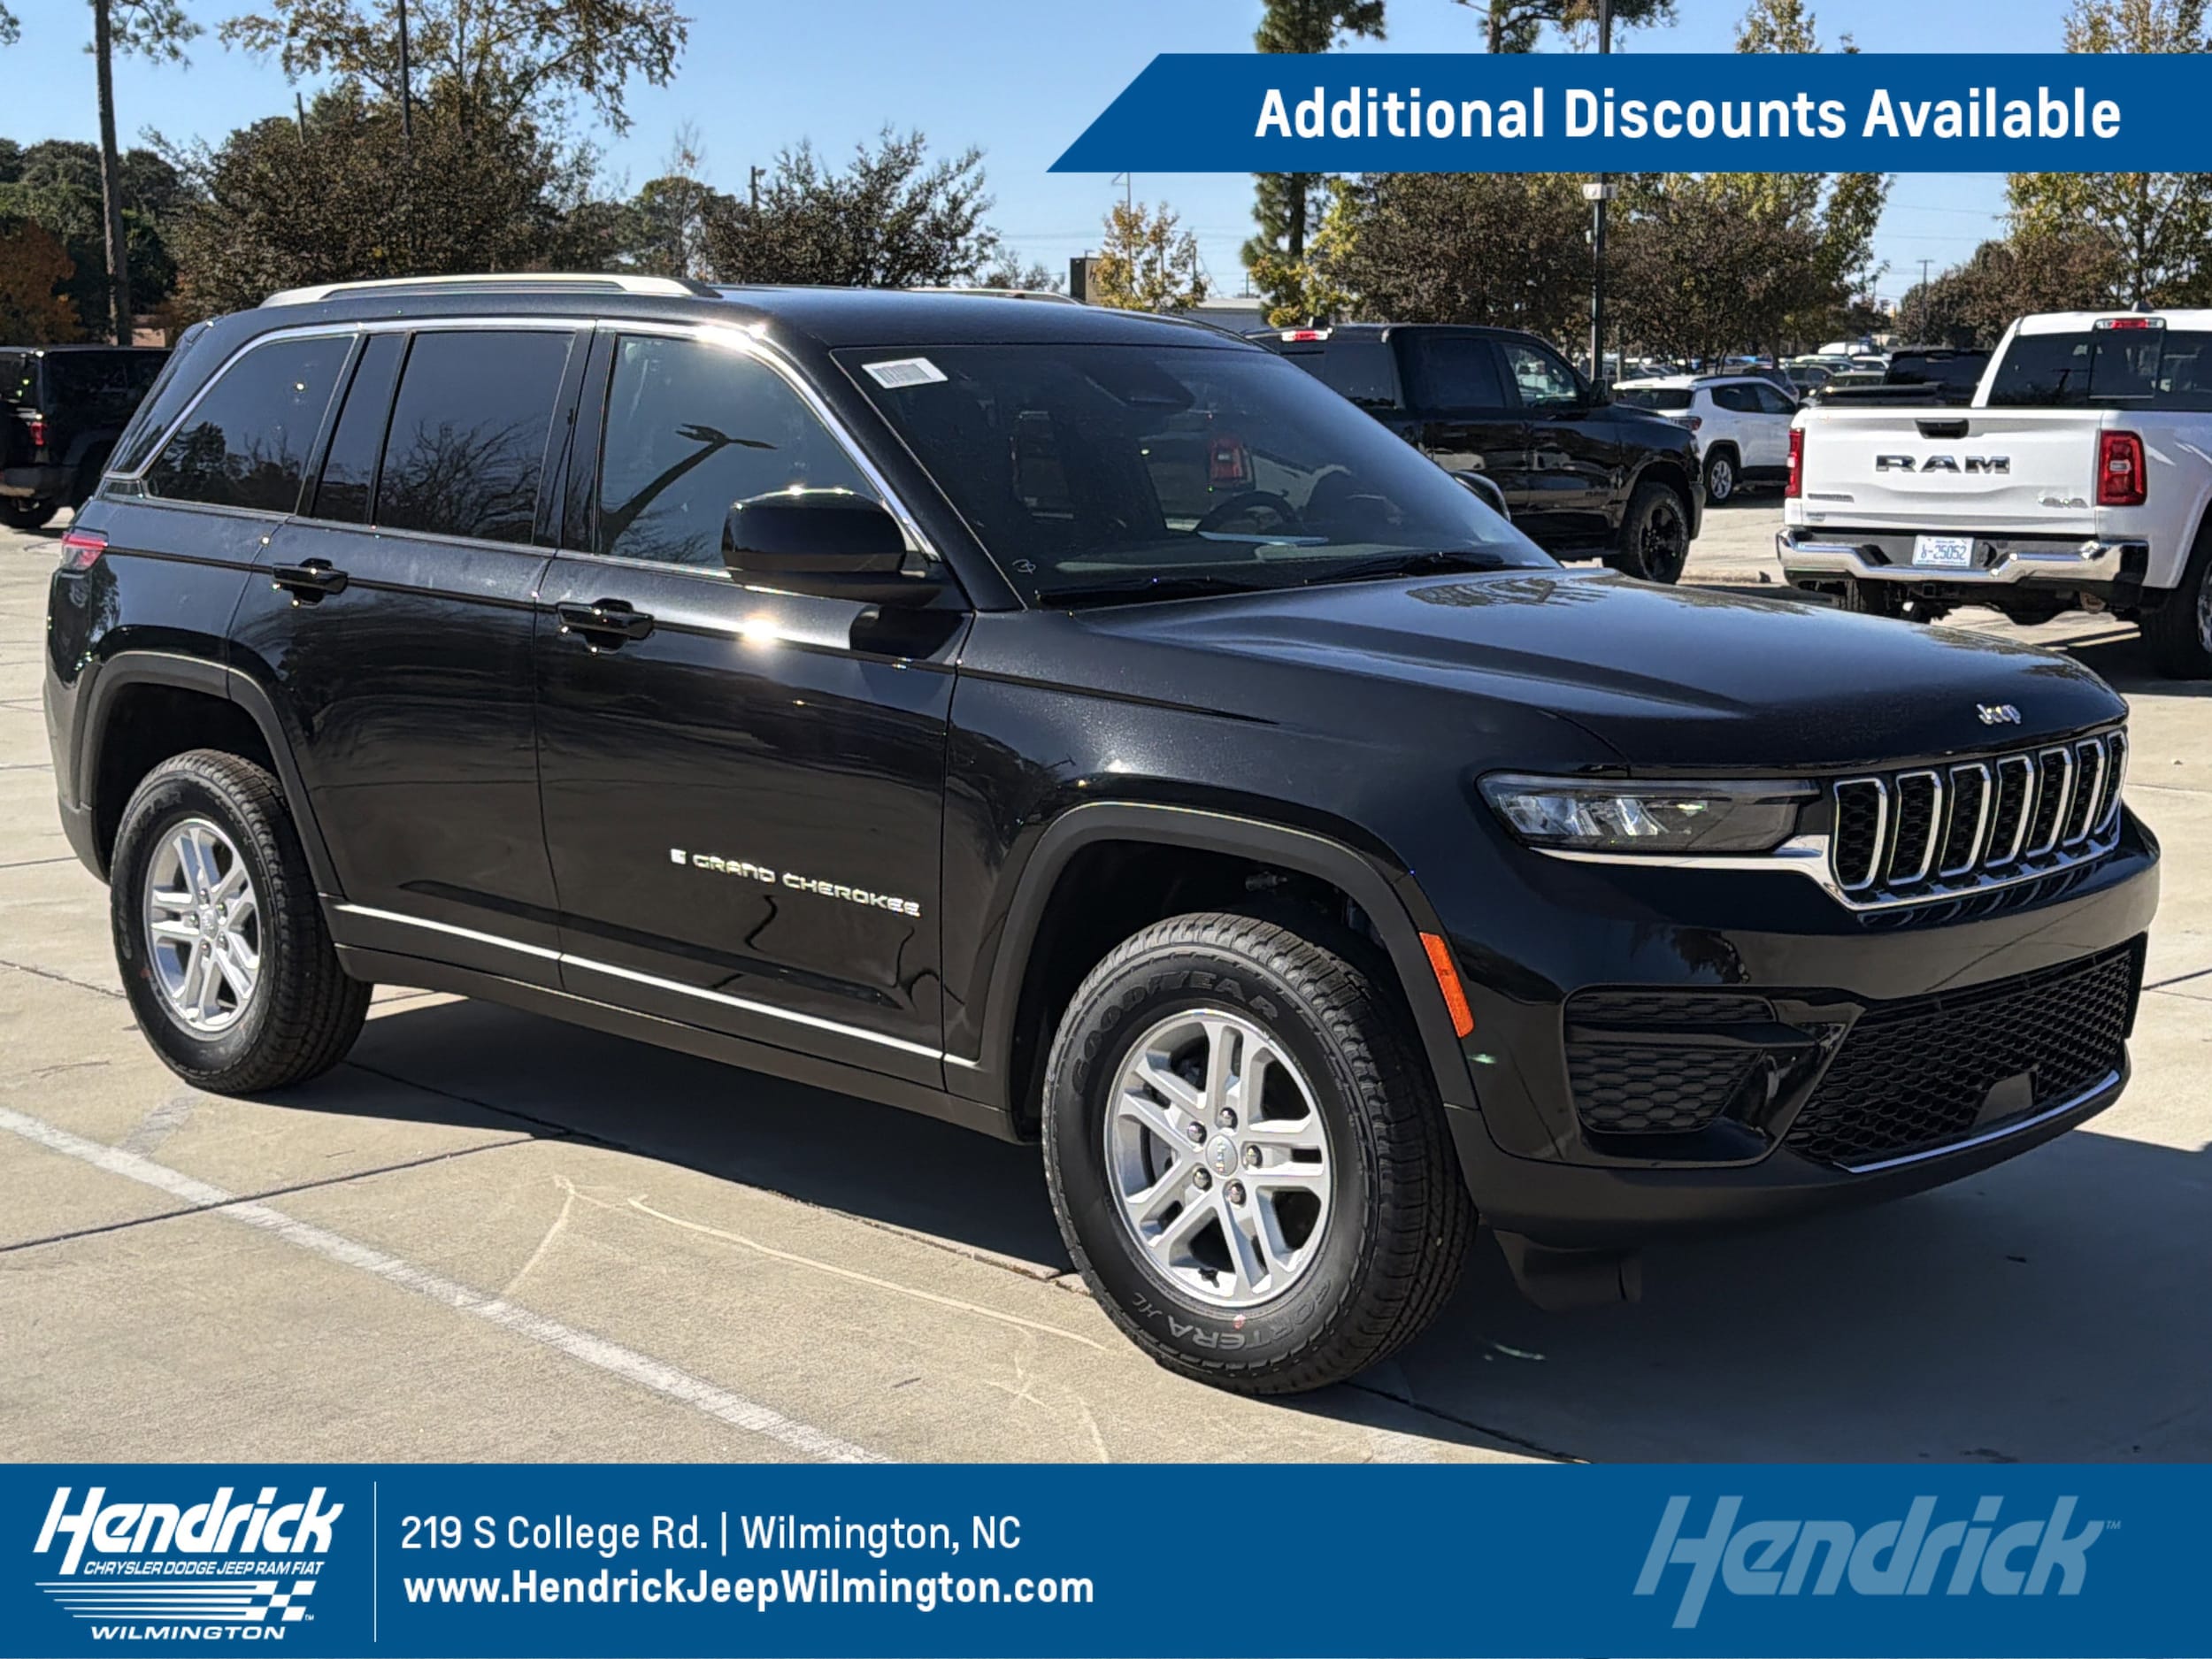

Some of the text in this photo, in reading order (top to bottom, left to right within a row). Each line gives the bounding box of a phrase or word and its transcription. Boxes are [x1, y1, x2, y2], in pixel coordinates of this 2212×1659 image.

[1876, 455, 2010, 474] RAM
[693, 853, 921, 917] GRAND CHEROKEE
[1071, 971, 1279, 1095] GOODYEAR
